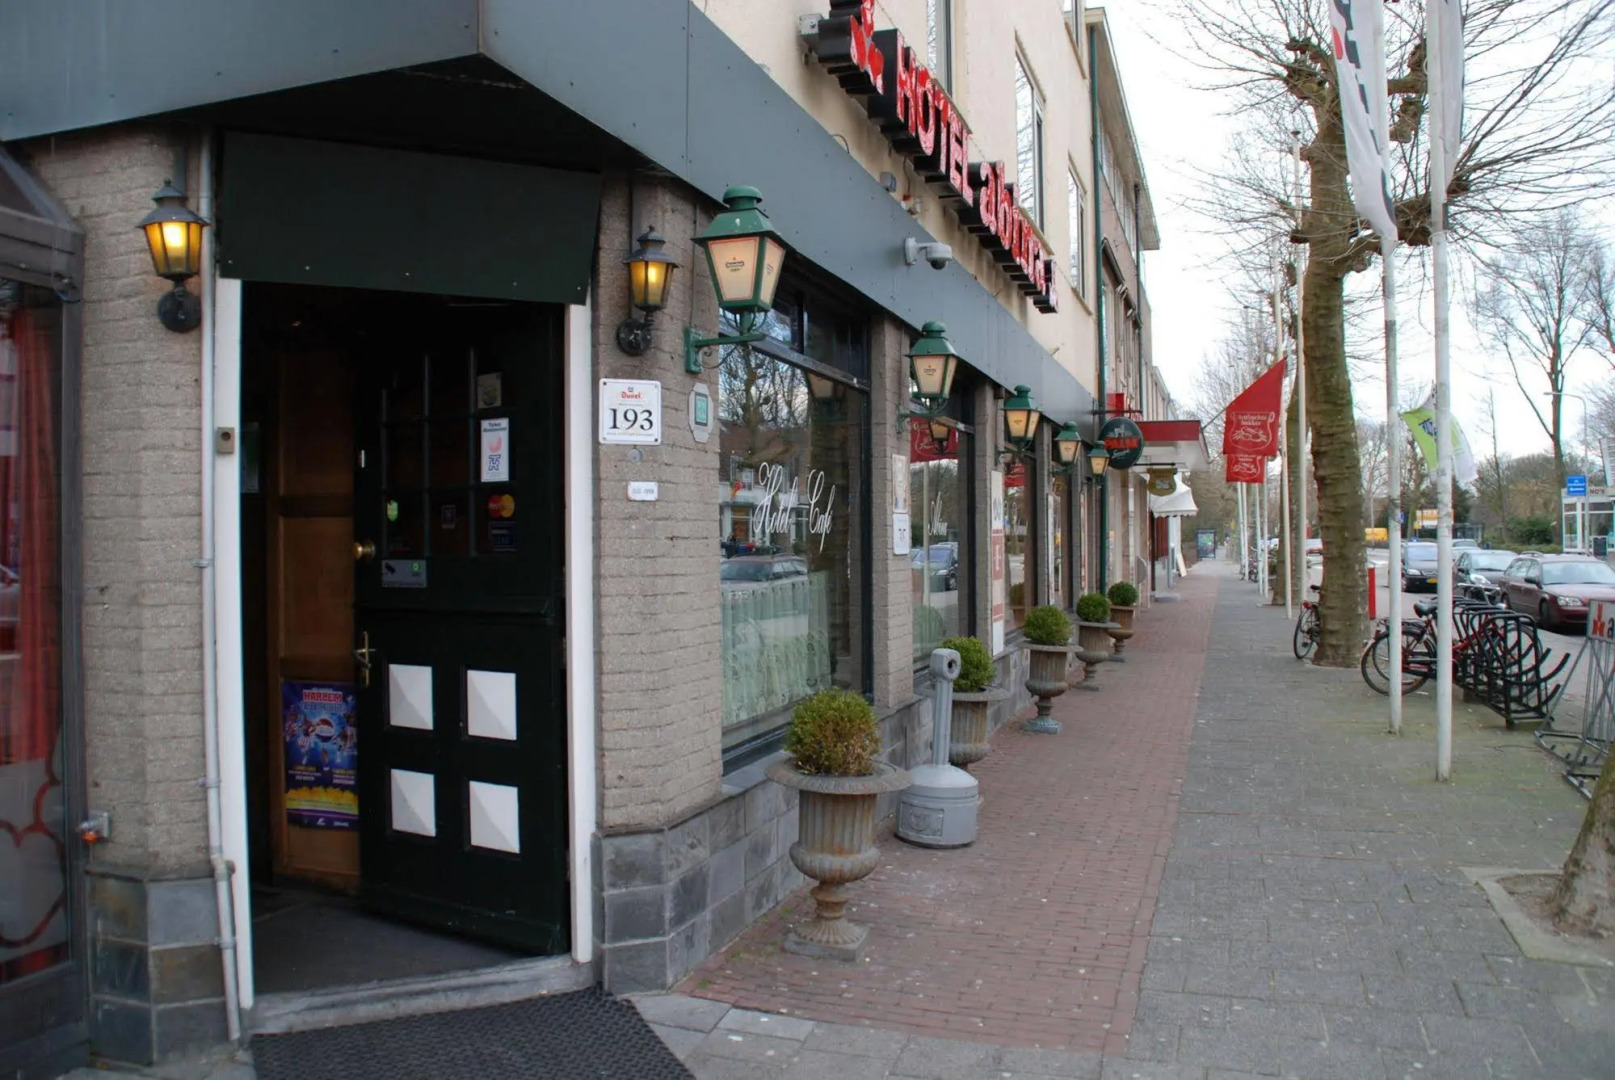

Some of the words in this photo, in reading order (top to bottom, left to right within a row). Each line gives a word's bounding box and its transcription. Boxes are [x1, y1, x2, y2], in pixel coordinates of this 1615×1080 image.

[896, 28, 973, 208] HOTEL
[609, 408, 653, 431] 193
[753, 462, 798, 533] Hotel
